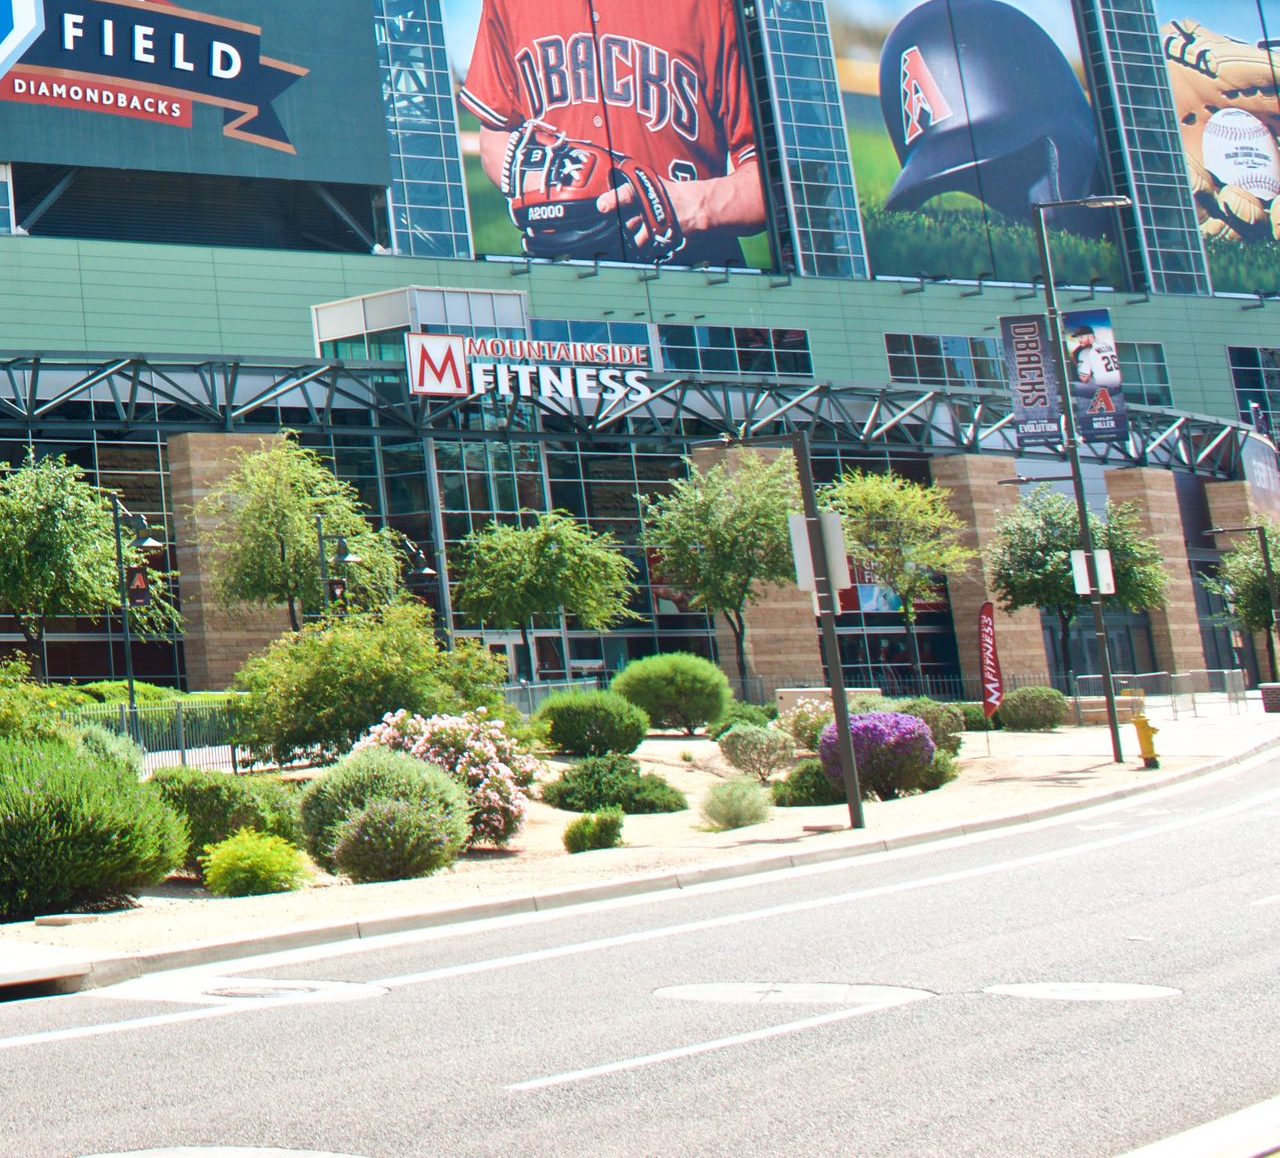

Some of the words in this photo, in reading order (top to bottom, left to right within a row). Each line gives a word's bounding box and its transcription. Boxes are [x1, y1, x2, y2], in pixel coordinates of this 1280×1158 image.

[61, 12, 243, 80] FIELD
[13, 78, 182, 118] DIAMONDBACKS
[528, 204, 565, 220] A2000
[465, 337, 650, 366] MOUNTAINSIDE
[470, 362, 653, 402] FITNESS
[1018, 423, 1058, 433] EVOLUTION
[1093, 421, 1116, 429] MILLER
